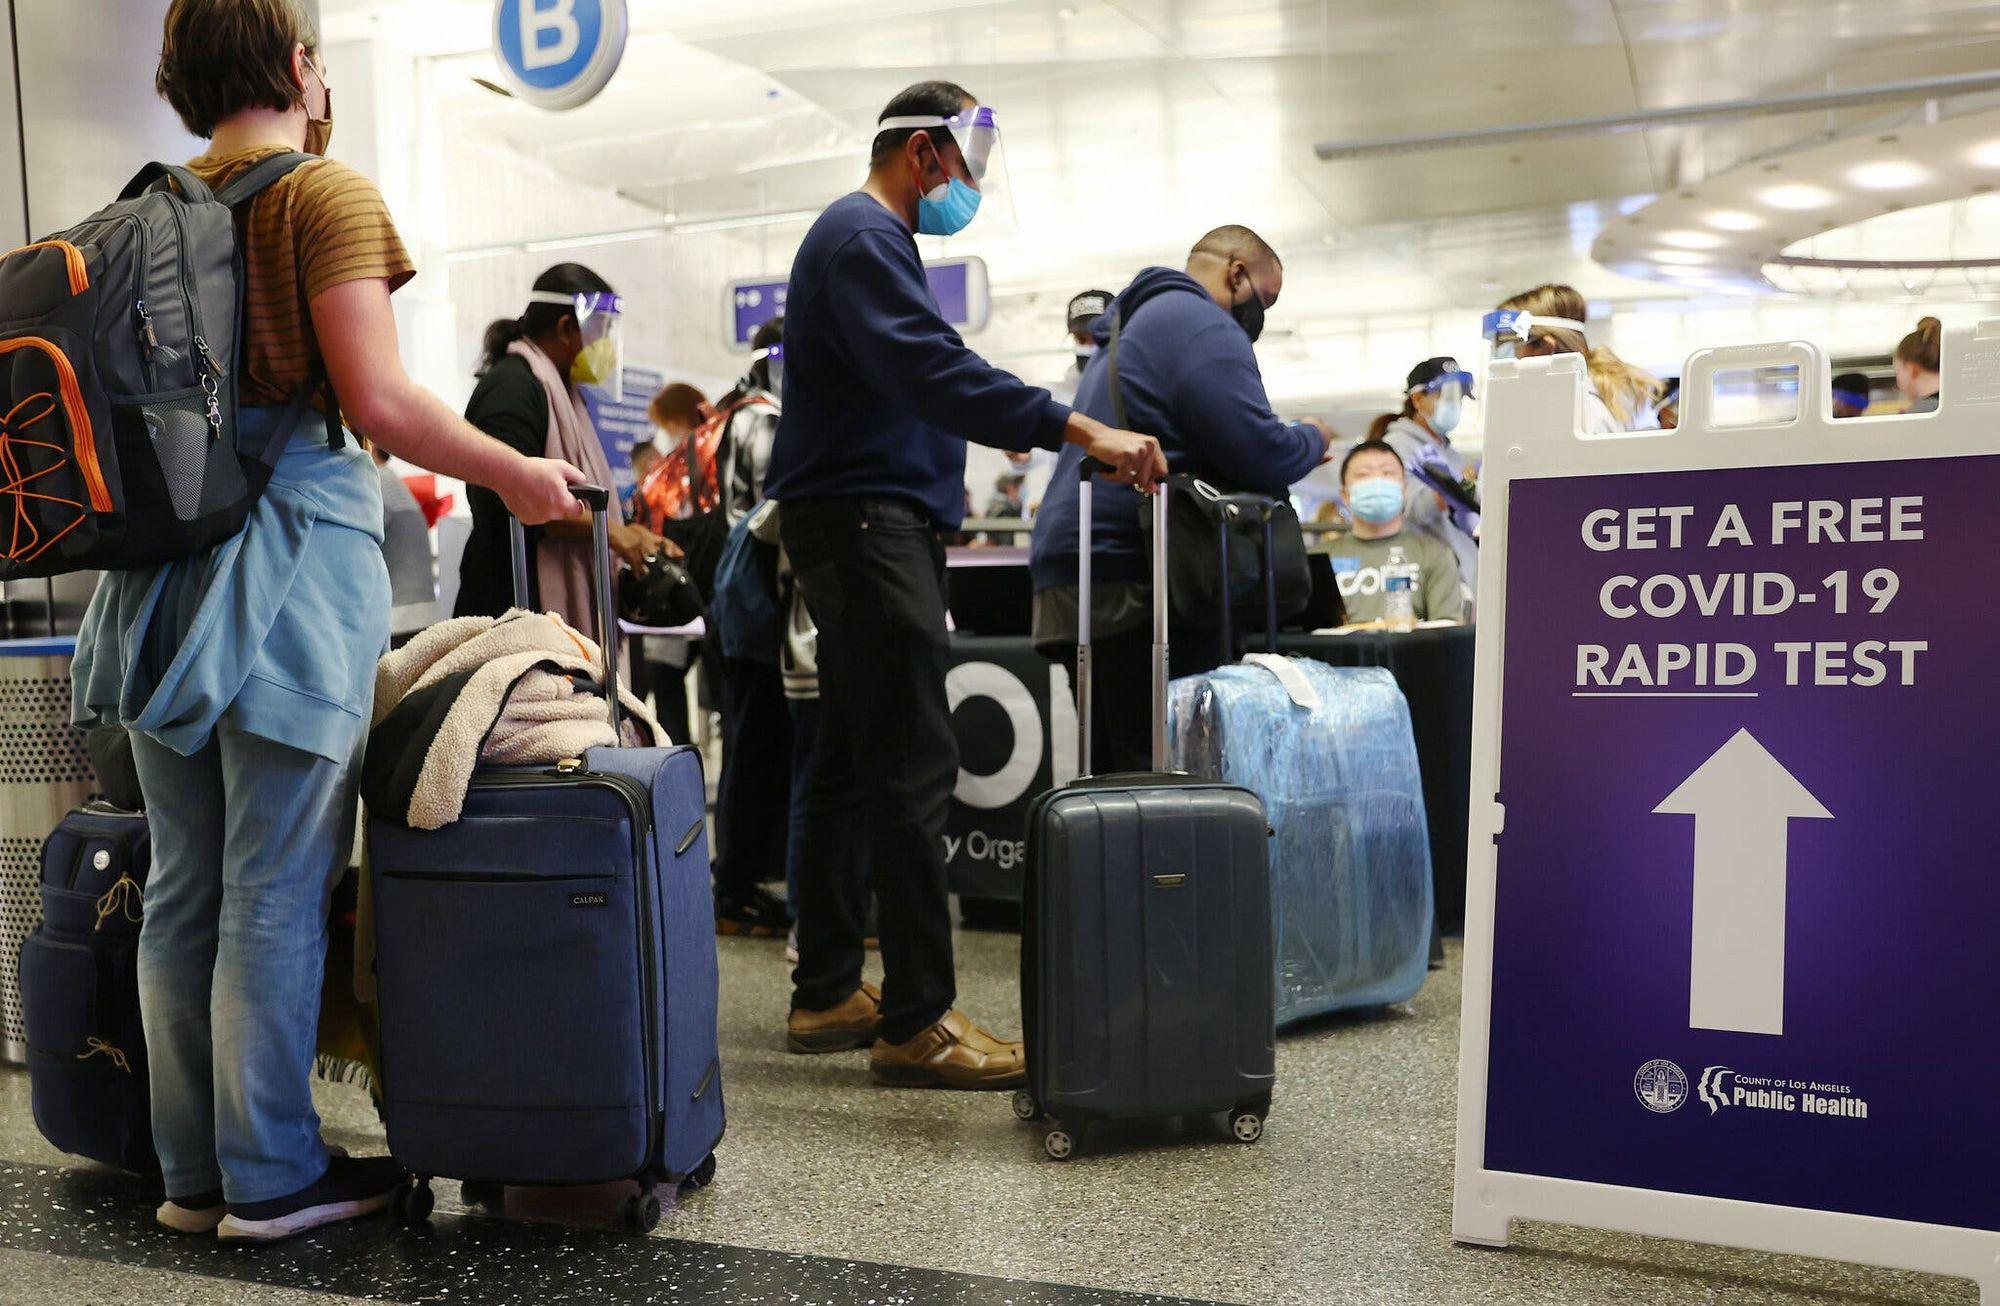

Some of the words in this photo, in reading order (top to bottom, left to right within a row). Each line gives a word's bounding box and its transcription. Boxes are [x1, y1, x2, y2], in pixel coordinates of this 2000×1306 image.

[518, 0, 581, 71] B
[1580, 505, 1695, 552] GET
[1706, 503, 1754, 548] A
[1771, 495, 1925, 545] FREE
[1599, 567, 1901, 619] COVID-19
[1574, 642, 1759, 687] RAPID
[1773, 640, 1929, 688] TEST
[573, 896, 604, 904] CALPAK
[1733, 1086, 1796, 1111] Public
[1802, 1093, 1868, 1118] Health
[1734, 1074, 1772, 1086] COUNTY
[1774, 1079, 1786, 1087] OF
[1789, 1079, 1806, 1089] LOS
[1809, 1081, 1851, 1093] ANGELES
